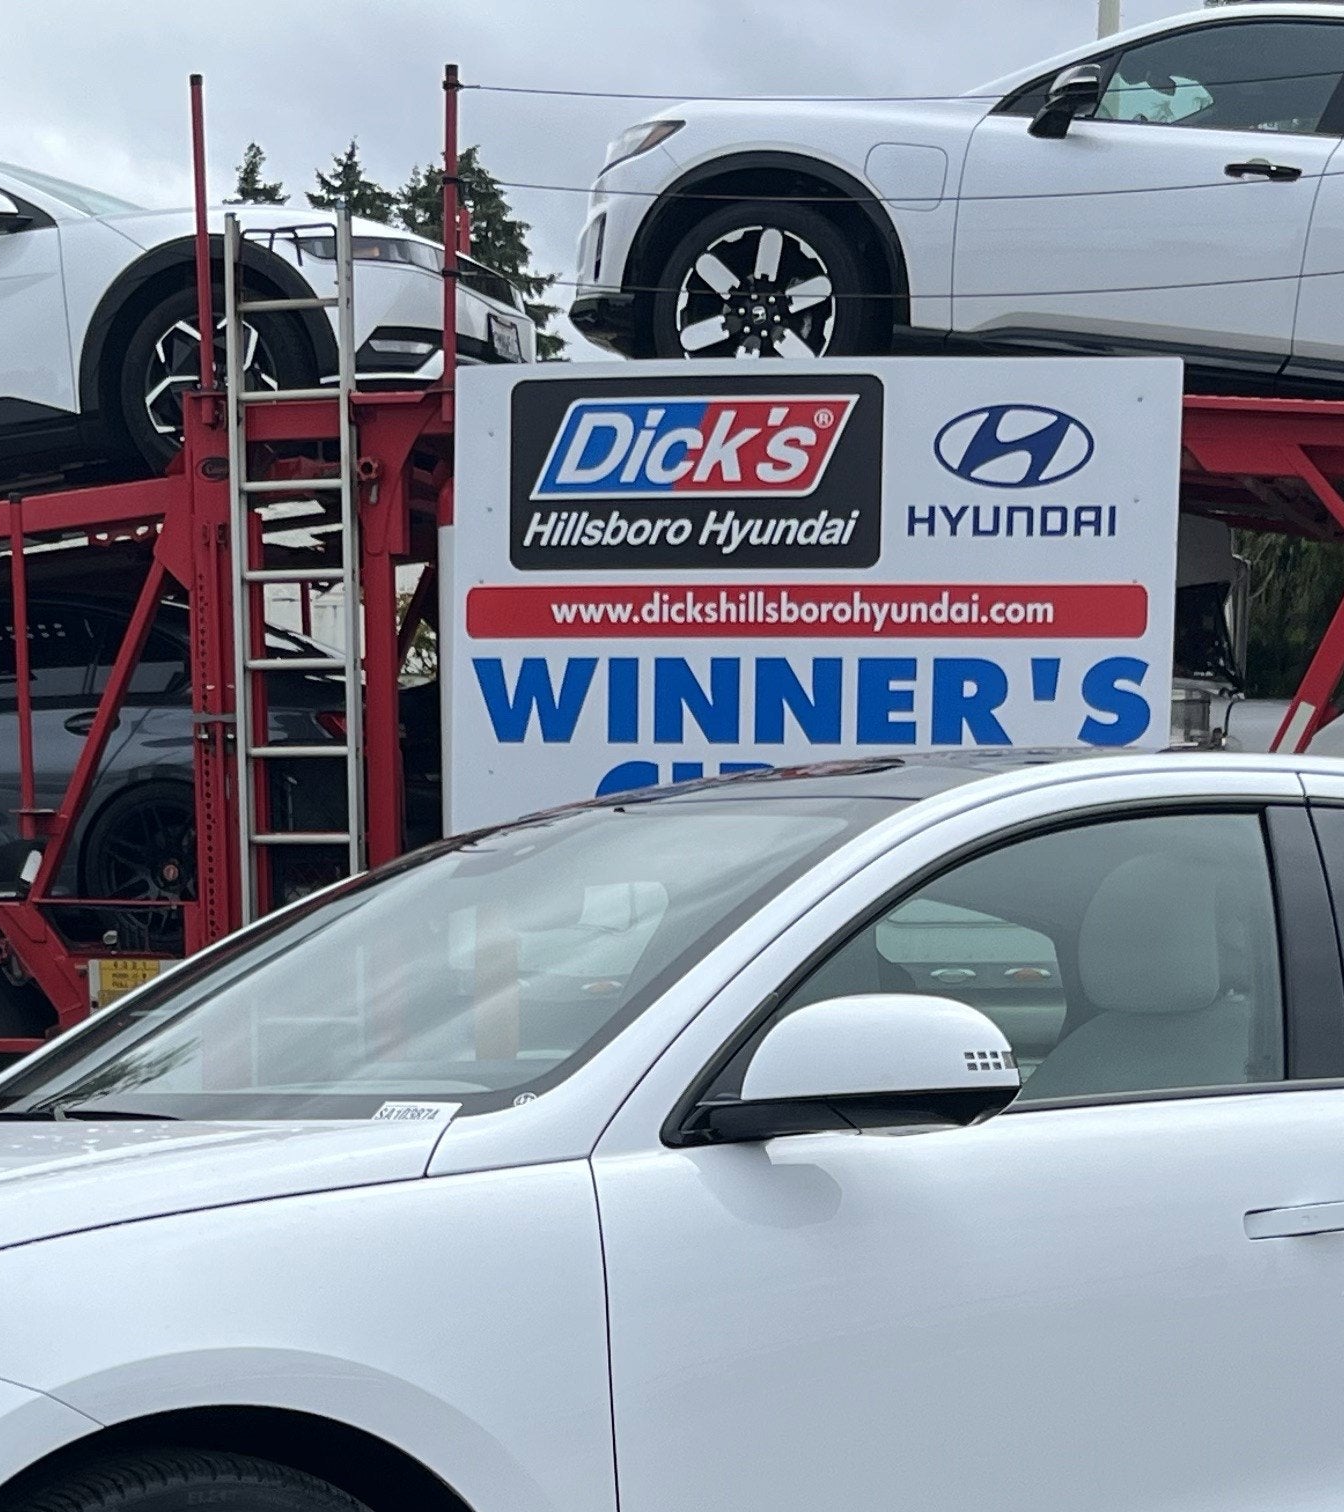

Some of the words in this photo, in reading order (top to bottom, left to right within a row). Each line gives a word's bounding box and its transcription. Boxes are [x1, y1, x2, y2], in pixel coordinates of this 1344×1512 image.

[555, 405, 819, 486] Dick's
[522, 510, 693, 547] Hillsboro
[698, 509, 860, 555] Hyundai
[907, 504, 1117, 537] HYUNDAI
[551, 590, 1054, 632] www.dickshillsborohyundai.com
[472, 656, 1152, 746] WINNER'S
